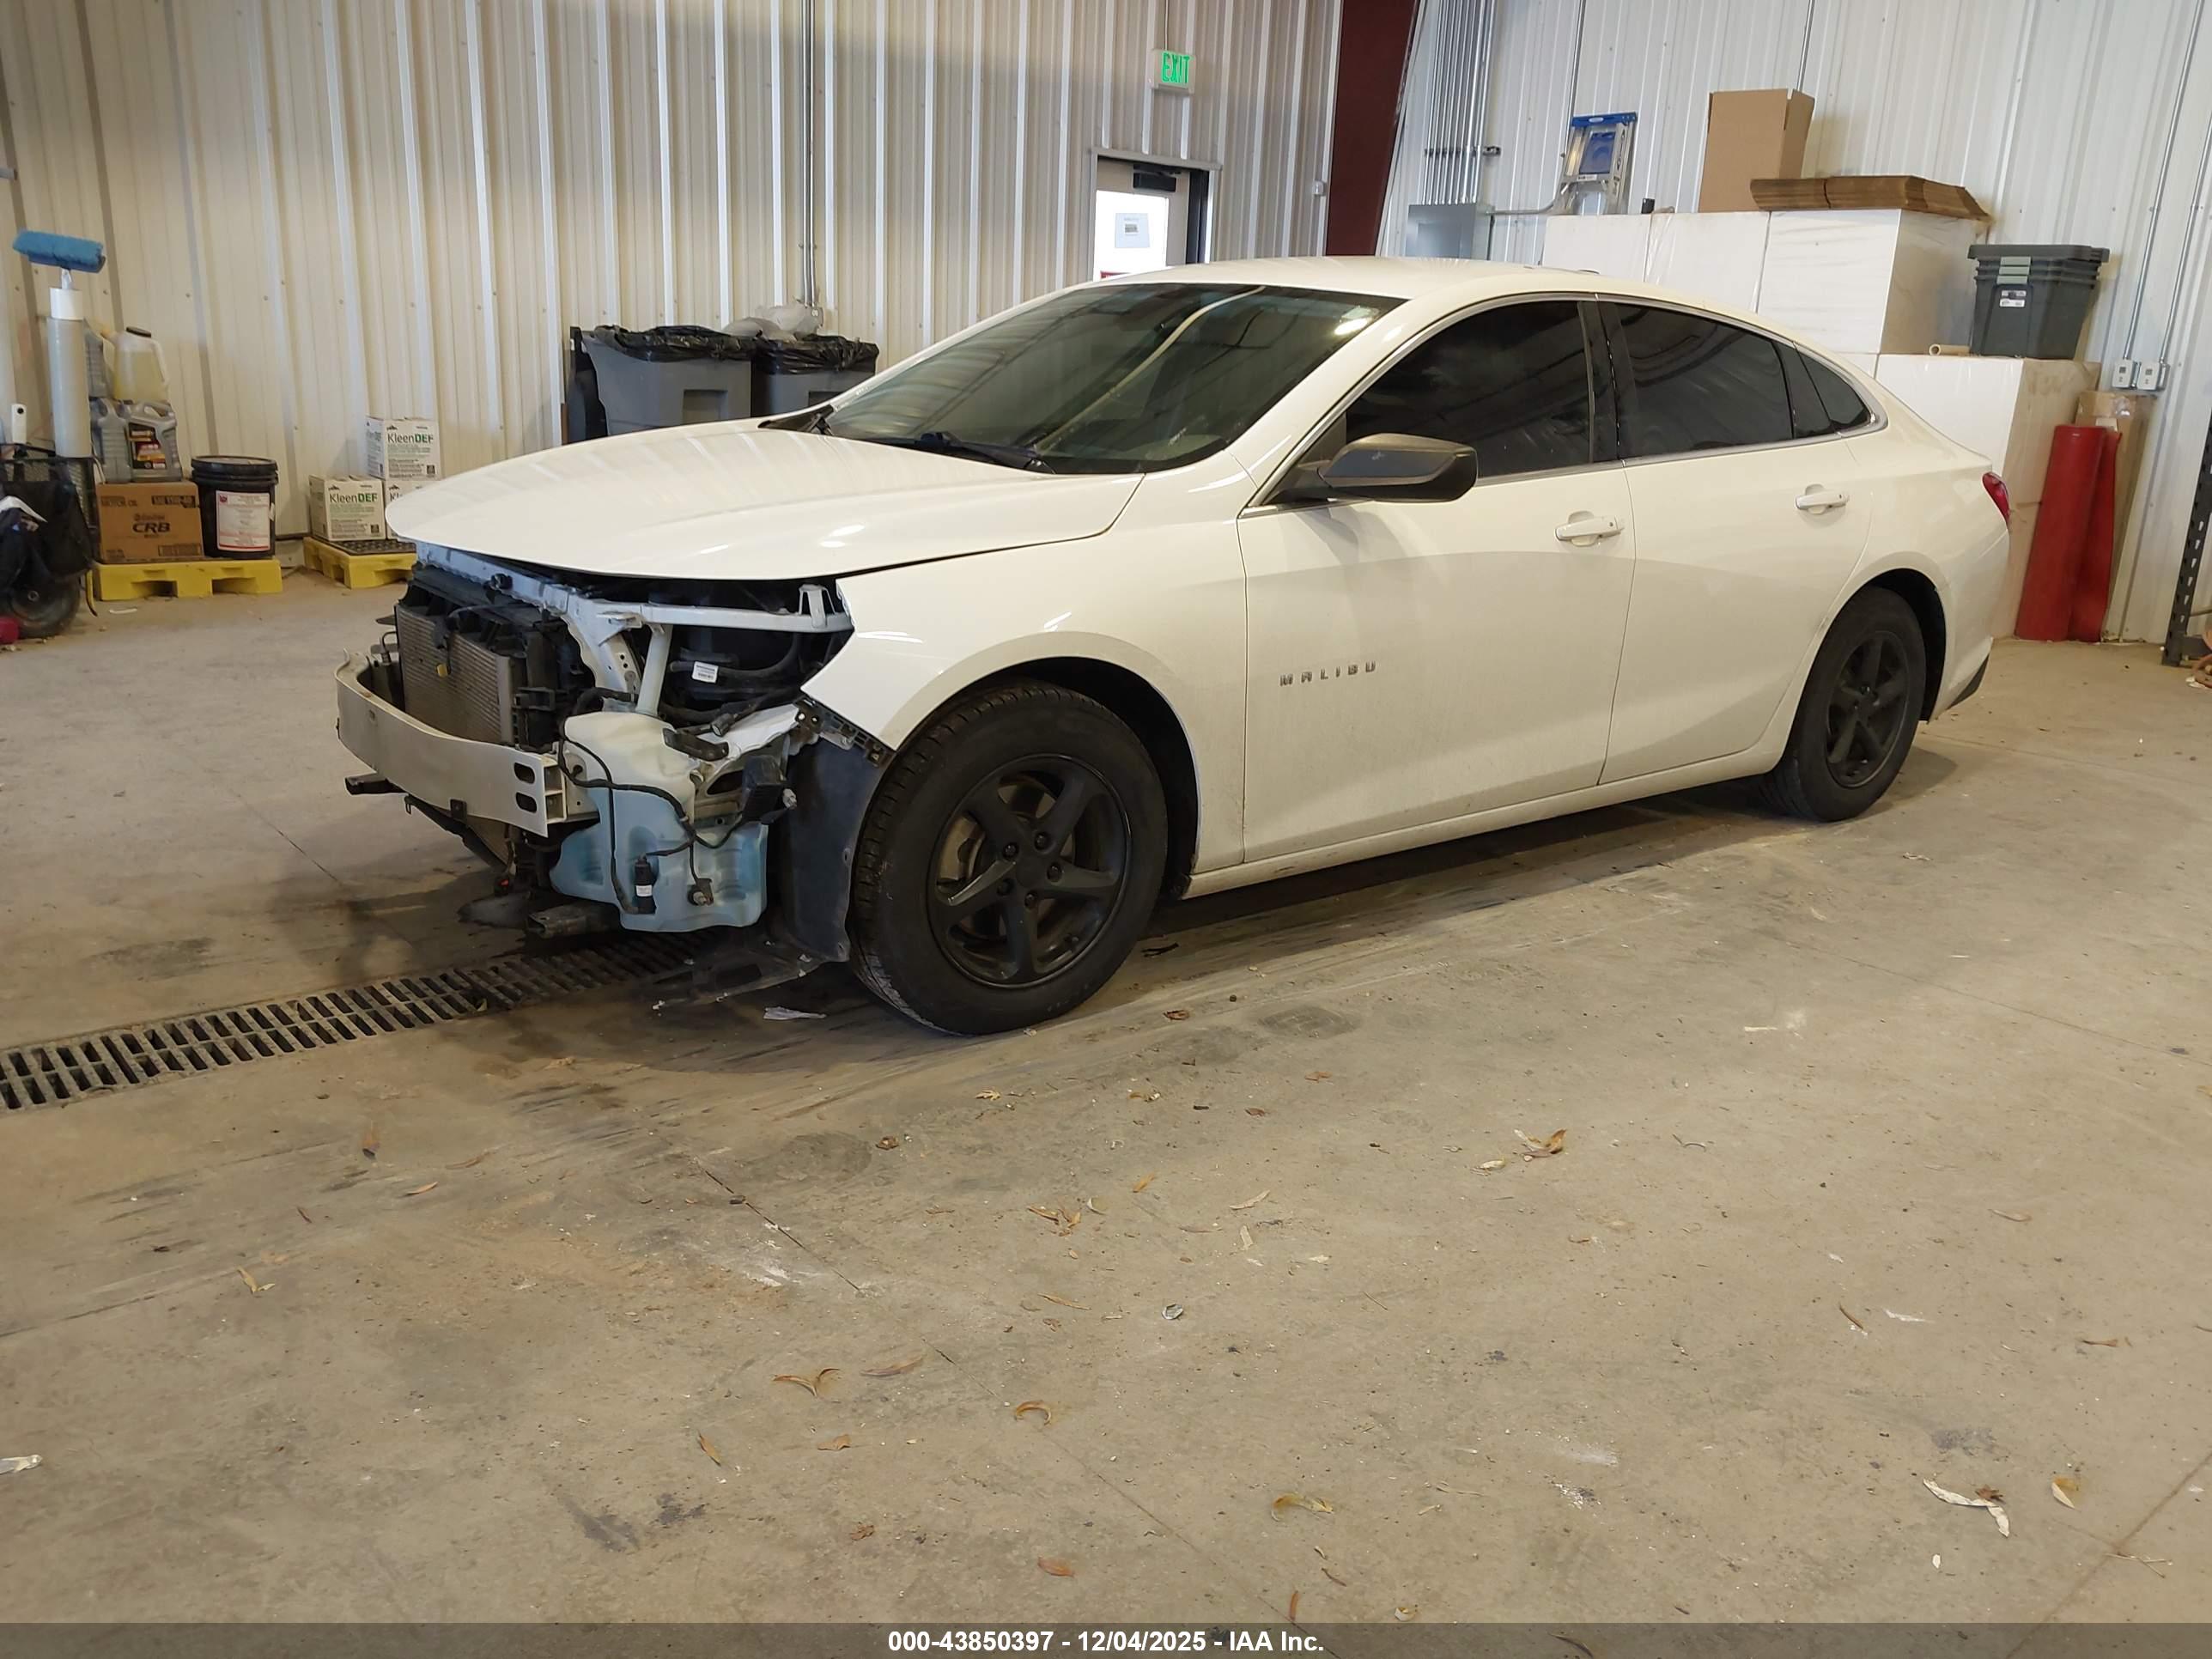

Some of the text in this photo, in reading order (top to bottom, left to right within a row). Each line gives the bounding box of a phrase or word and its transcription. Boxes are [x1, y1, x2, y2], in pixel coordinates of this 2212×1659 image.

[1162, 52, 1190, 83] EXIT
[387, 433, 434, 444] KleenDEF
[330, 493, 378, 503] KleenDEF
[132, 522, 171, 533] CRB
[1279, 660, 1376, 686] MALIBU
